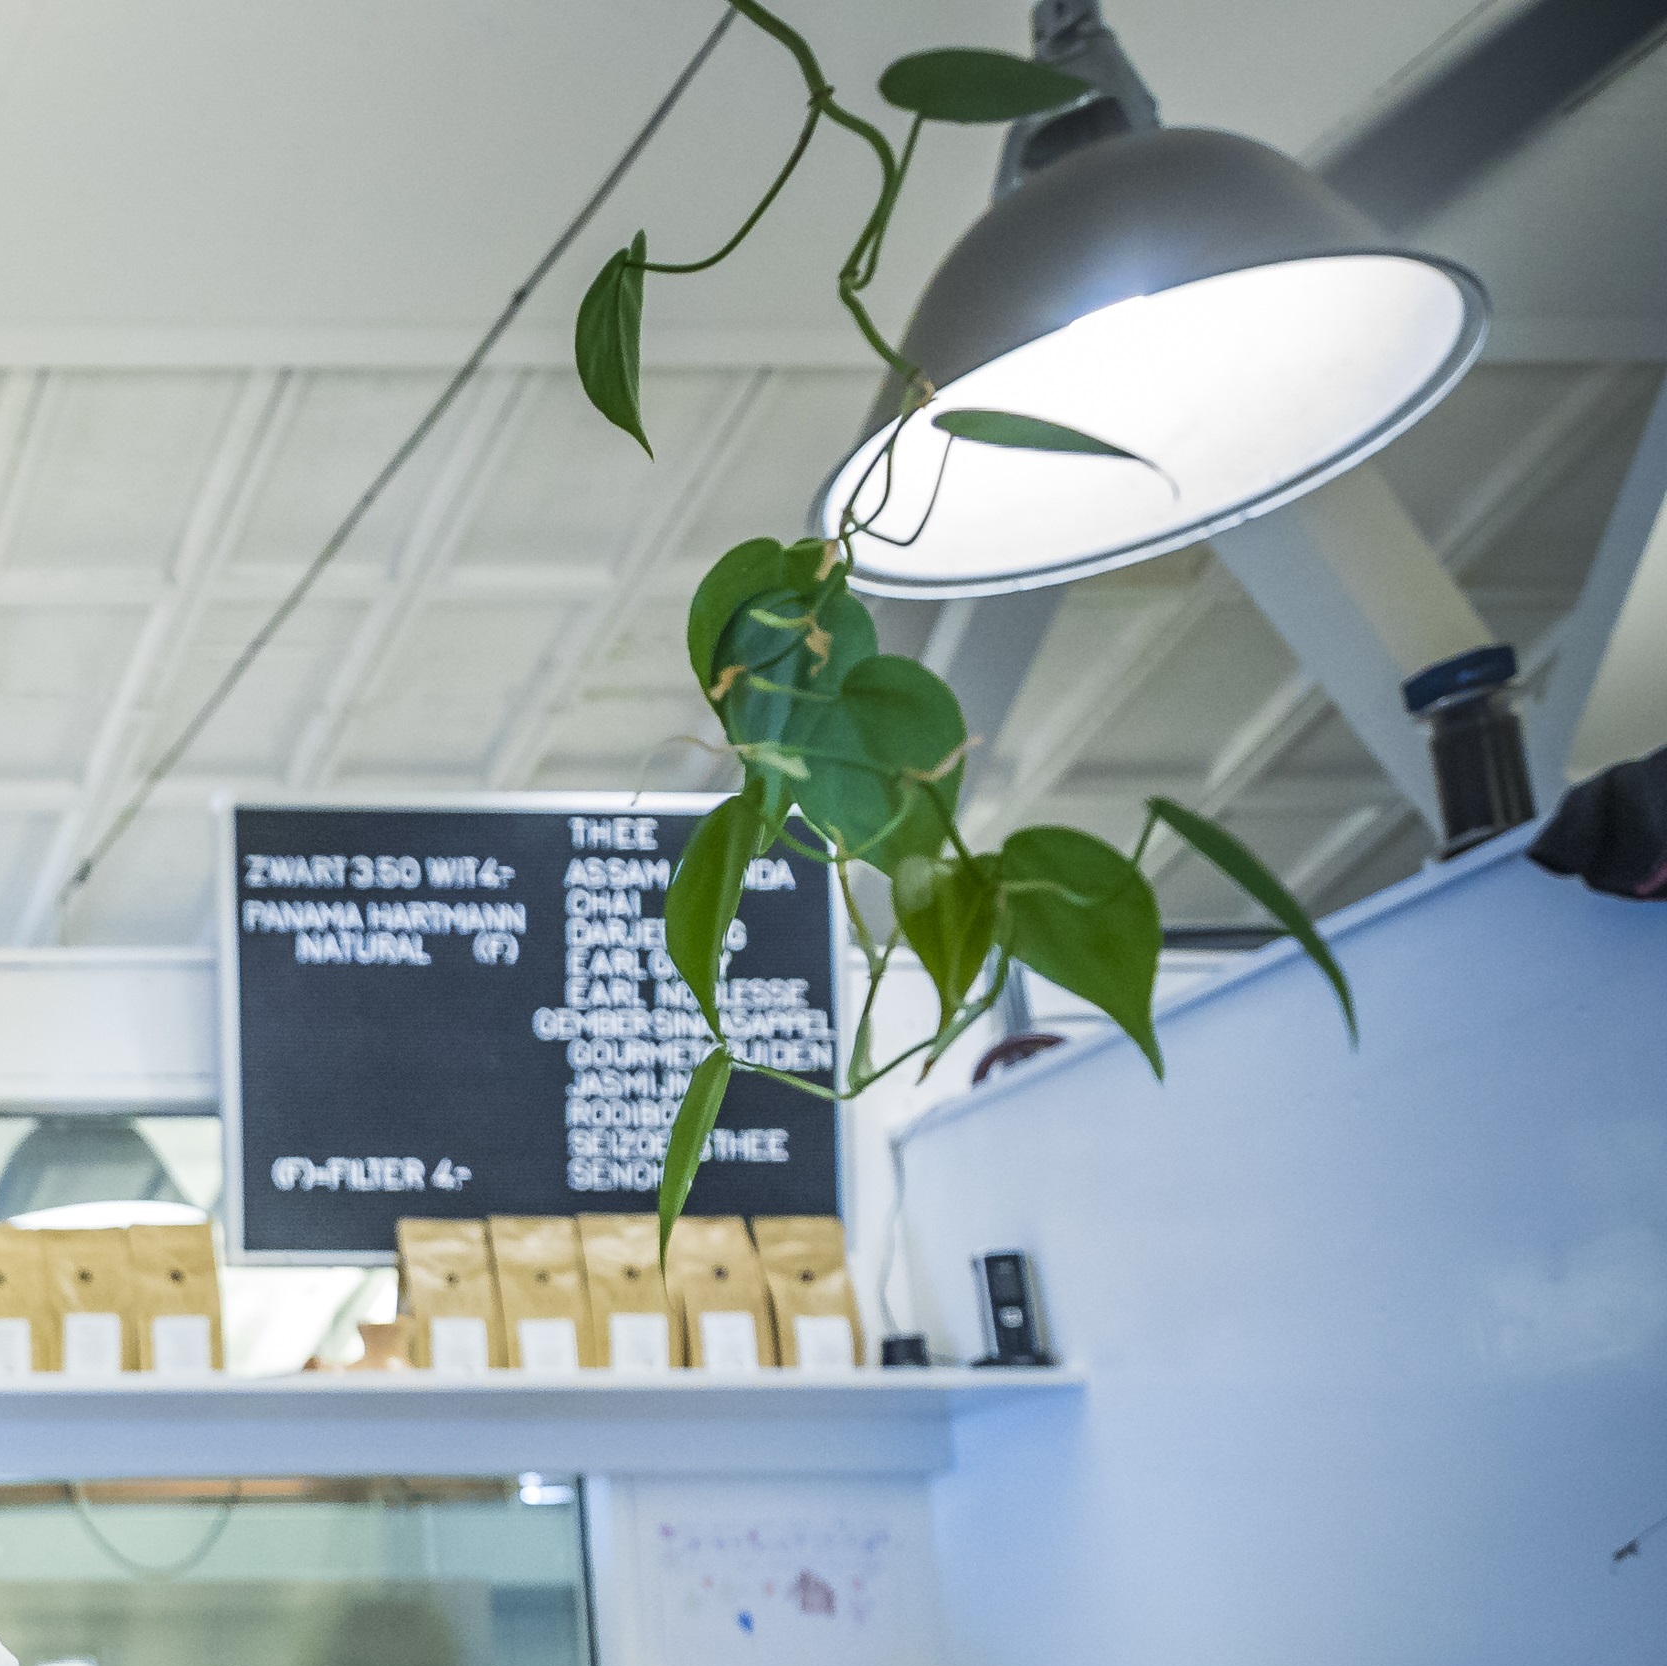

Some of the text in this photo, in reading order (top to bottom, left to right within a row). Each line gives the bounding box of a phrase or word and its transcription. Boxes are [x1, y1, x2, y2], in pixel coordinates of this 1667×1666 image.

[568, 816, 659, 850] THEE
[243, 854, 347, 888] ZWART
[425, 856, 480, 889] WIT
[564, 857, 671, 890] ASSAM
[243, 900, 527, 935] PANAMA HARTMANN
[295, 930, 433, 965] NATURAL
[566, 918, 748, 951] DARJEG
[566, 948, 648, 981] EARL
[565, 976, 810, 1009] EARL NOLESSE
[566, 1098, 682, 1130] ROOIBO
